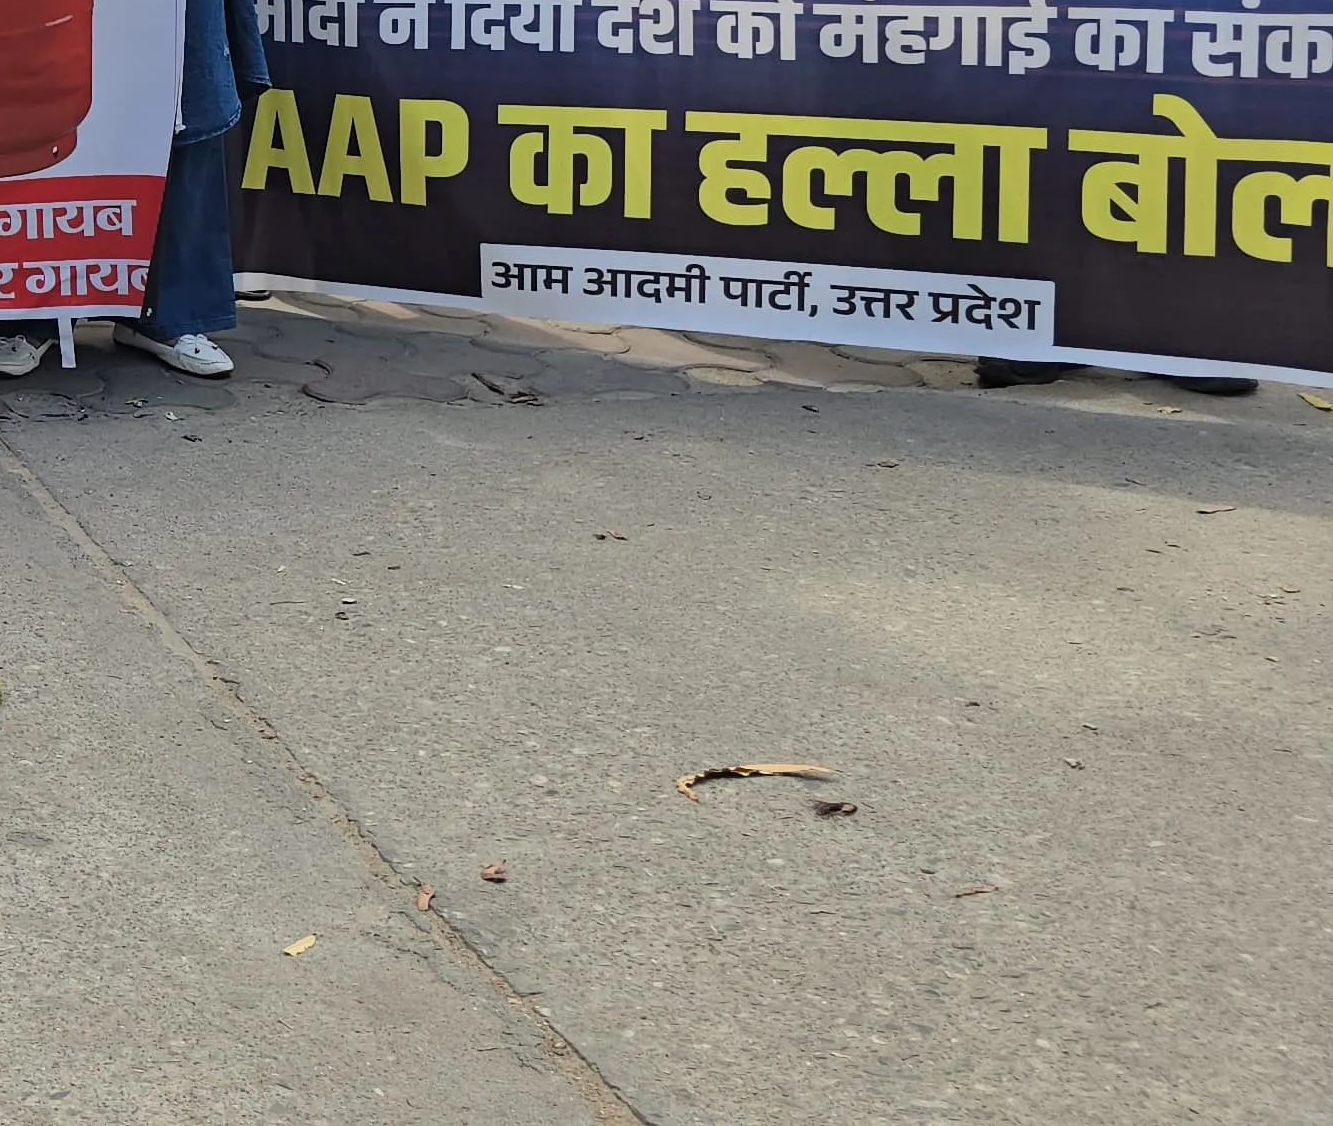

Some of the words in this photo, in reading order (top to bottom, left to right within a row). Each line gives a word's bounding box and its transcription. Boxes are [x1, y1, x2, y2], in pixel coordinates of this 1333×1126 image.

[1068, 7, 1174, 74] का
[241, 88, 470, 207] AAP
[497, 104, 668, 220] का
[685, 110, 1048, 245] हल्ला
[1068, 92, 1333, 268] बोल
[491, 261, 574, 295] आम
[583, 263, 711, 305] आदमी
[719, 270, 819, 317] पार्टी,
[830, 284, 920, 321] उत्तर
[928, 283, 1041, 331] प्रदेश
